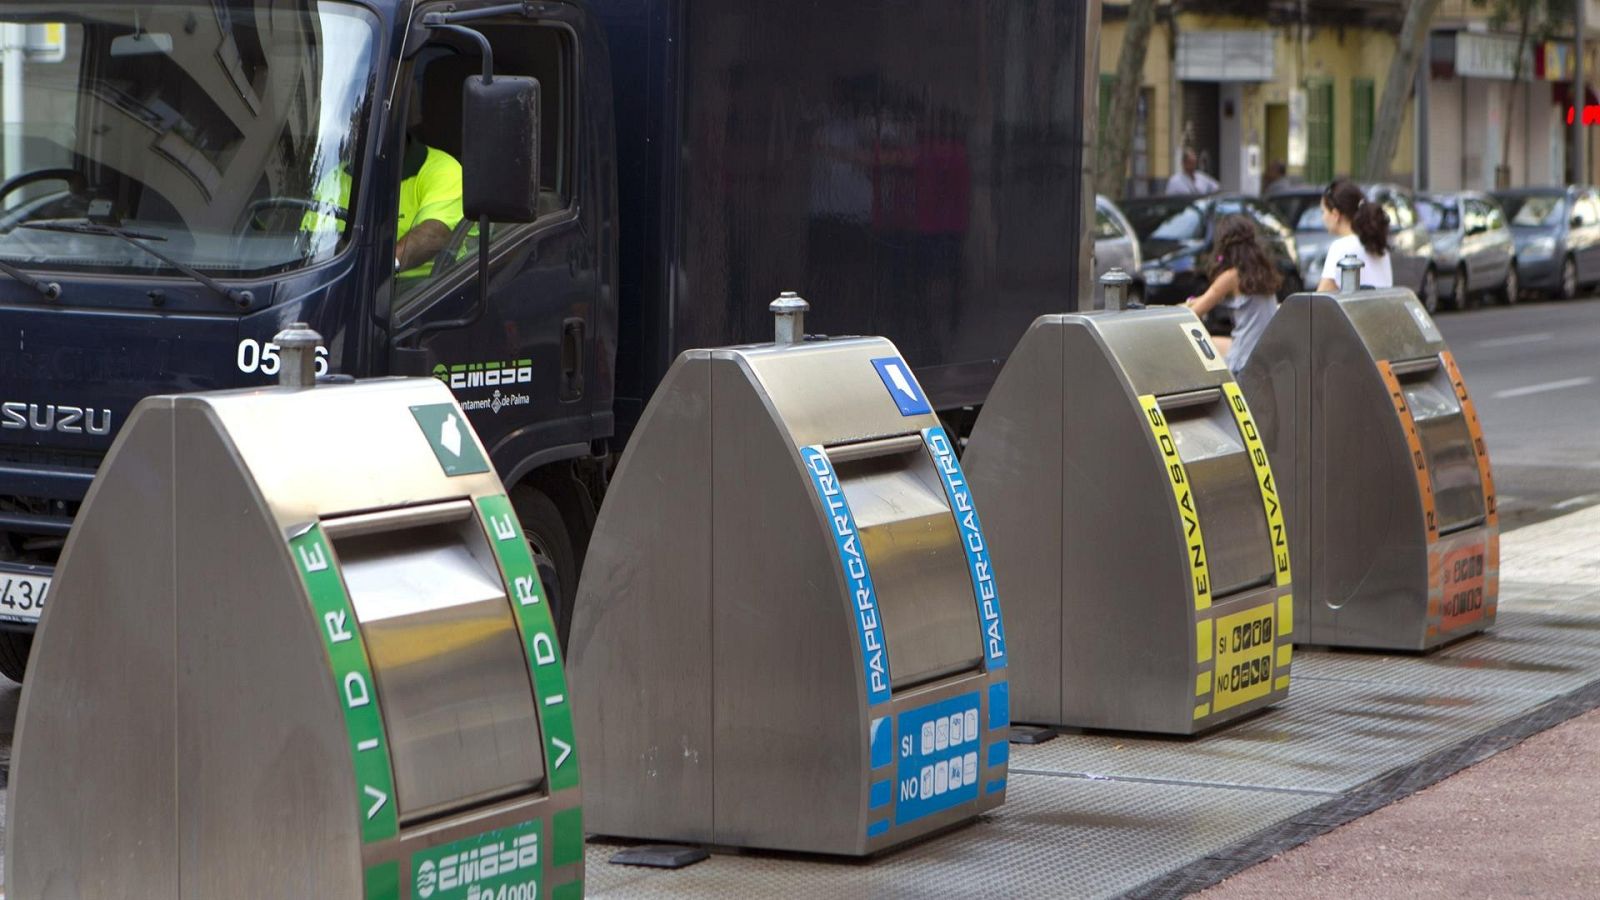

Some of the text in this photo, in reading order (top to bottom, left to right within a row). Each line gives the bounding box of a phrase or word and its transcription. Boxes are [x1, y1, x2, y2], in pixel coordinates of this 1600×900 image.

[237, 338, 329, 377] 056
[501, 394, 510, 406] de
[510, 392, 530, 406] Palma
[1149, 406, 1208, 596] ENVASOS
[1232, 393, 1289, 573] ENVASOS
[808, 452, 887, 694] PAPER-CARTRÓ
[928, 434, 1004, 660] PAPER-CARTRÓ
[302, 541, 388, 820] VIDRE
[490, 512, 573, 770] VIDRE
[1217, 673, 1229, 694] NO
[1219, 636, 1227, 654] SI
[900, 776, 919, 802] NO
[901, 734, 913, 758] SI
